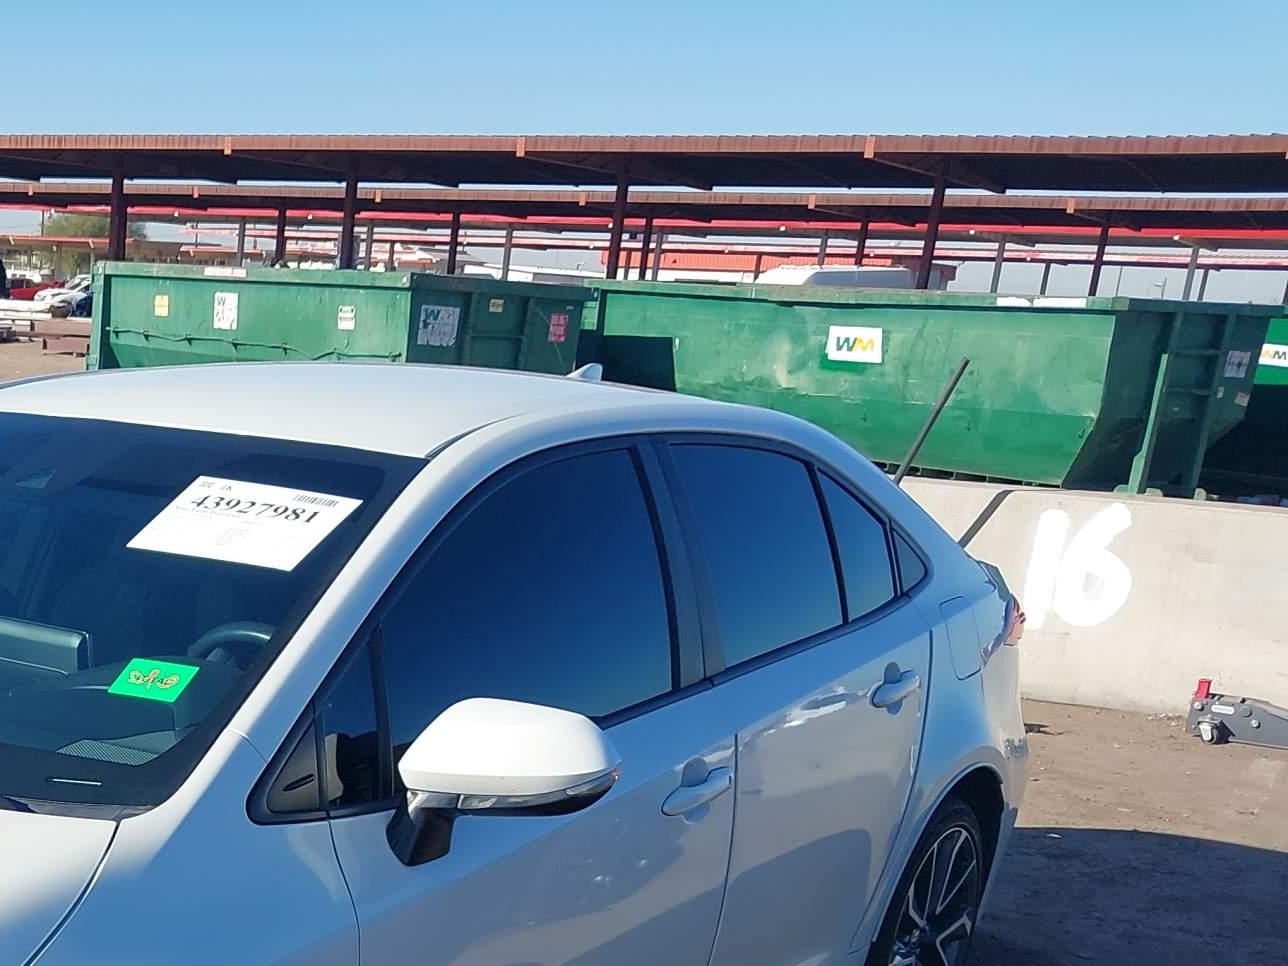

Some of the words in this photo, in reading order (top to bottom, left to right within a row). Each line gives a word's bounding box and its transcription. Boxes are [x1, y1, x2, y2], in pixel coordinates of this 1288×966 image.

[836, 336, 874, 352] WM
[190, 495, 320, 524] 43927981
[1022, 502, 1132, 630] 16
